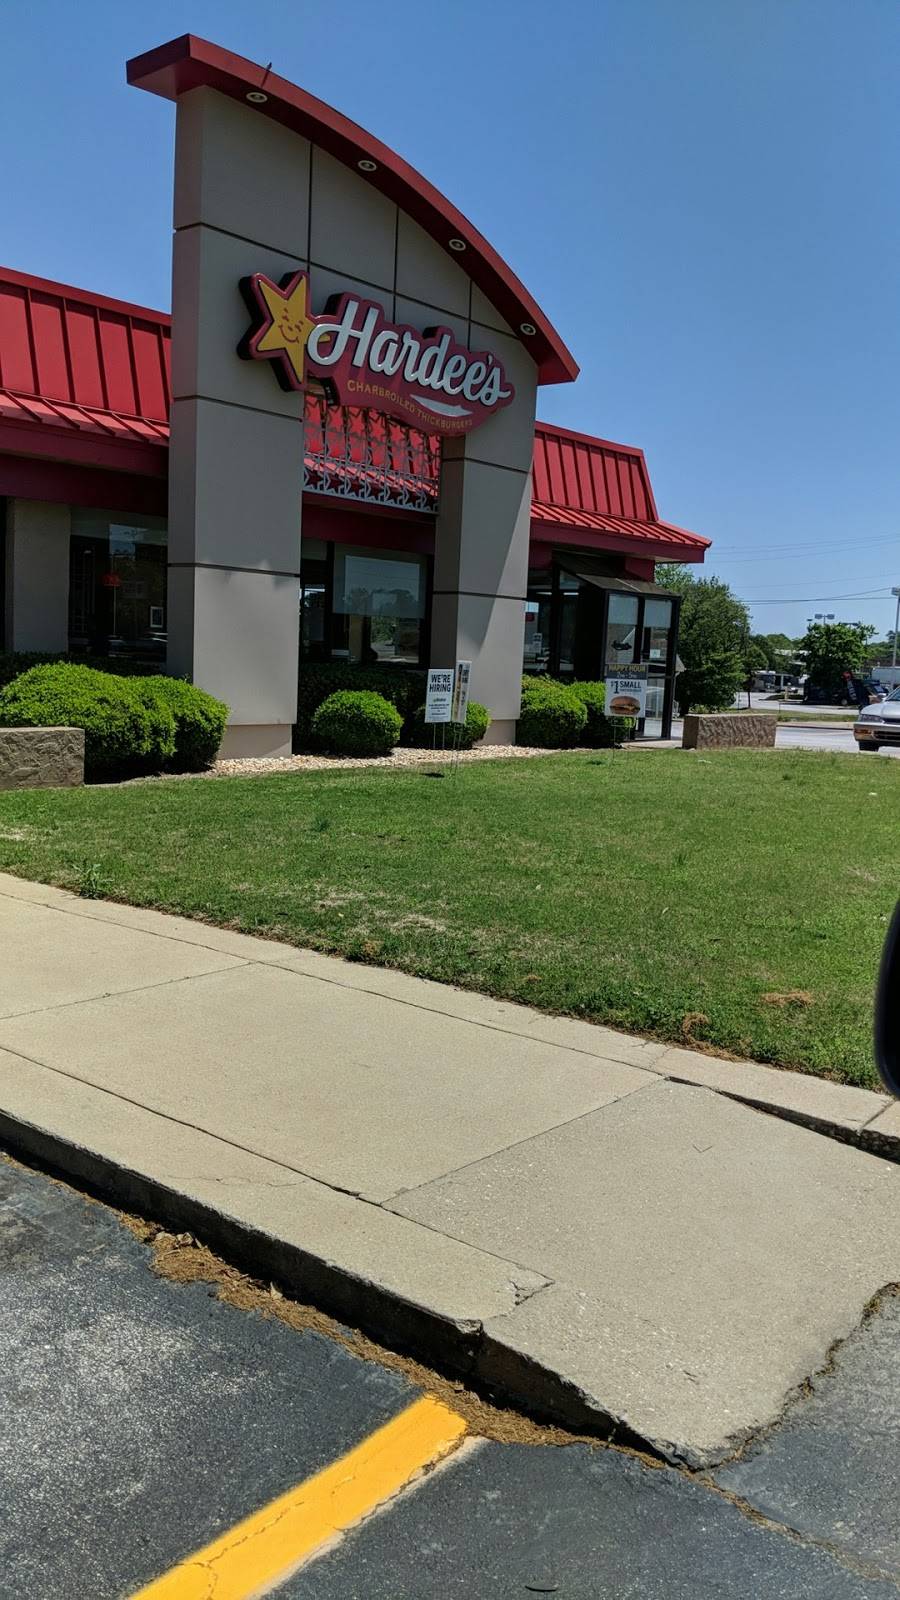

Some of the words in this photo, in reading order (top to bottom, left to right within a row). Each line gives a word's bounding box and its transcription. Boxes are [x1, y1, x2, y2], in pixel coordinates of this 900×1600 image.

[307, 300, 511, 406] Hardee's
[346, 379, 415, 413] CHARBROILED
[416, 408, 473, 430] THICKBURGERS
[429, 684, 451, 692] HIRING
[431, 674, 451, 683] WE'RE
